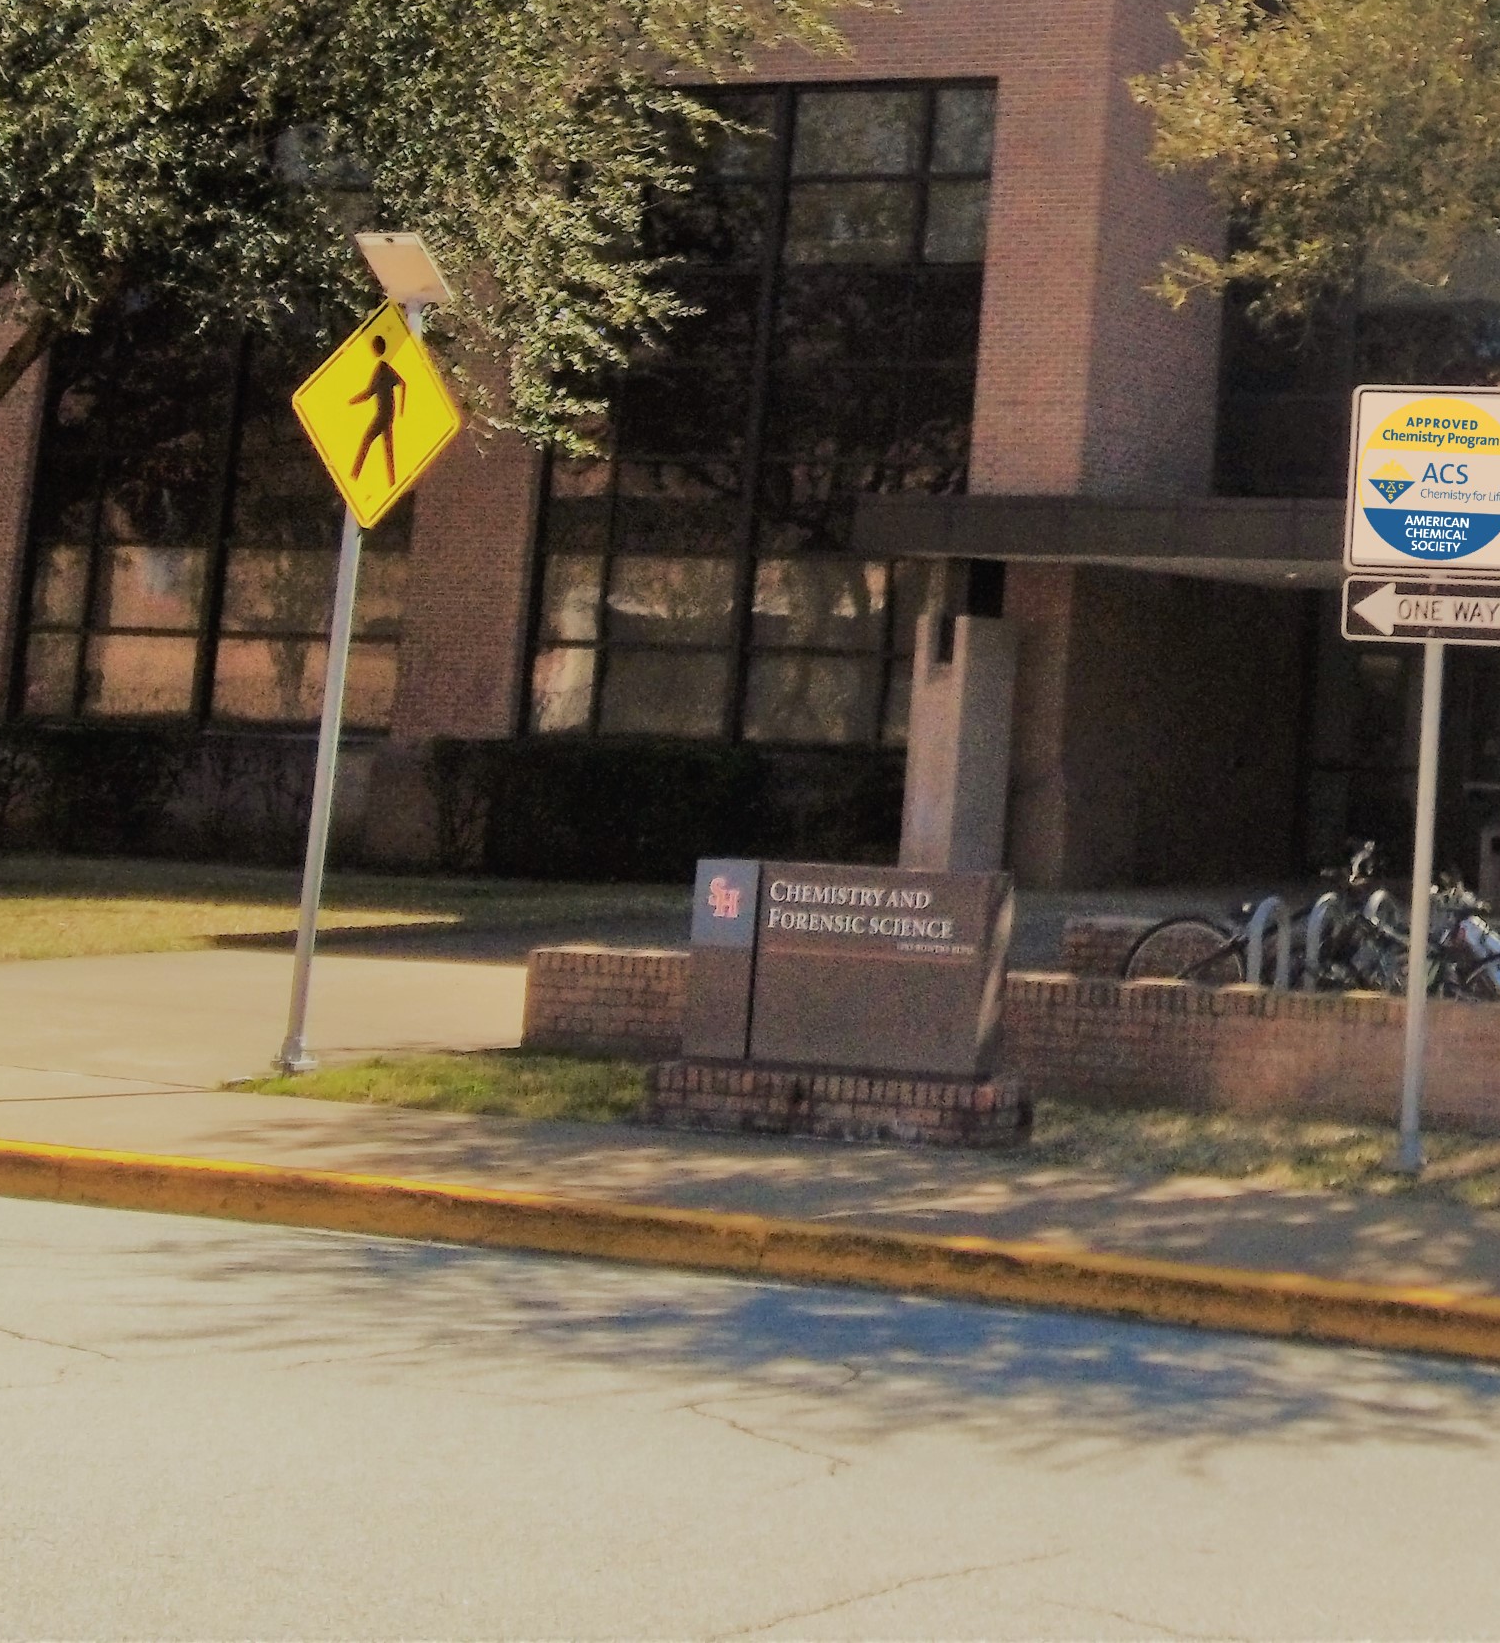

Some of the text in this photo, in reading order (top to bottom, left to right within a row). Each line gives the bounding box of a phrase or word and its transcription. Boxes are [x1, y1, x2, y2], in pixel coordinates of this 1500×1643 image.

[1406, 417, 1479, 430] APPROVED
[1382, 429, 1500, 449] Chemistry Program
[1421, 462, 1469, 485] ACS
[1420, 488, 1471, 504] Chemistry
[1472, 490, 1486, 502] for
[1404, 515, 1470, 529] AMERICAN
[1405, 528, 1468, 541] CHEMICAL
[1411, 540, 1461, 553] SOCIETY
[1398, 598, 1500, 623] ONE WAY
[769, 881, 933, 910] CHEMISTRY AND
[767, 908, 954, 939] FORENSIC SCIENCE
